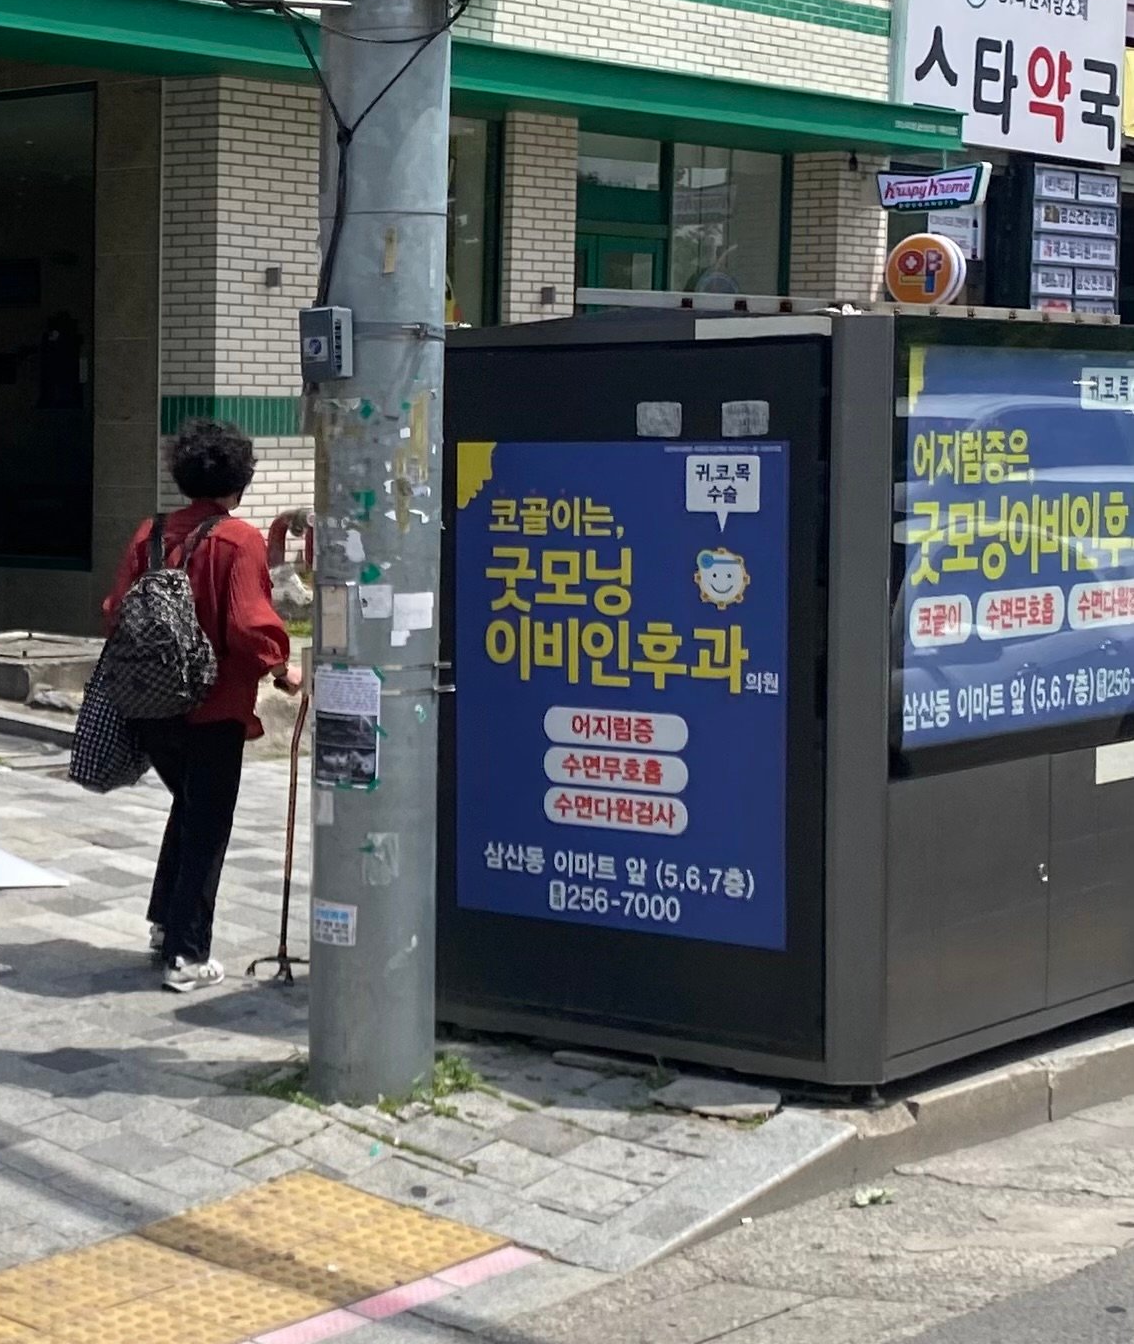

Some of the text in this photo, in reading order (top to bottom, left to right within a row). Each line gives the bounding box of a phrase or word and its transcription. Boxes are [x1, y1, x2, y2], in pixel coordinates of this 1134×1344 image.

[912, 25, 1120, 152] 스타약국
[884, 175, 973, 201] Krispy Kreme
[897, 248, 943, 294] 약
[695, 463, 751, 483] 귀,코,목
[707, 485, 739, 504] 수술
[488, 496, 625, 540] 코골이는,
[907, 491, 1134, 586] 굿모닝이비인후
[485, 546, 633, 617] 굿모닝
[917, 601, 962, 637] 코골이
[985, 592, 1055, 631] 수면무호흡
[485, 616, 780, 695] 이비인후과 의원
[903, 689, 952, 732] 삼산동
[957, 683, 1005, 723] 이마트
[1010, 677, 1026, 716] 앞
[571, 712, 655, 744] 어지럼증
[561, 753, 664, 786] 수면무호흡
[552, 793, 676, 830] 수면다원검사
[484, 841, 755, 899] 삼산동 이마트 앞 (5,6,7층)
[566, 881, 681, 923] 256-7000
